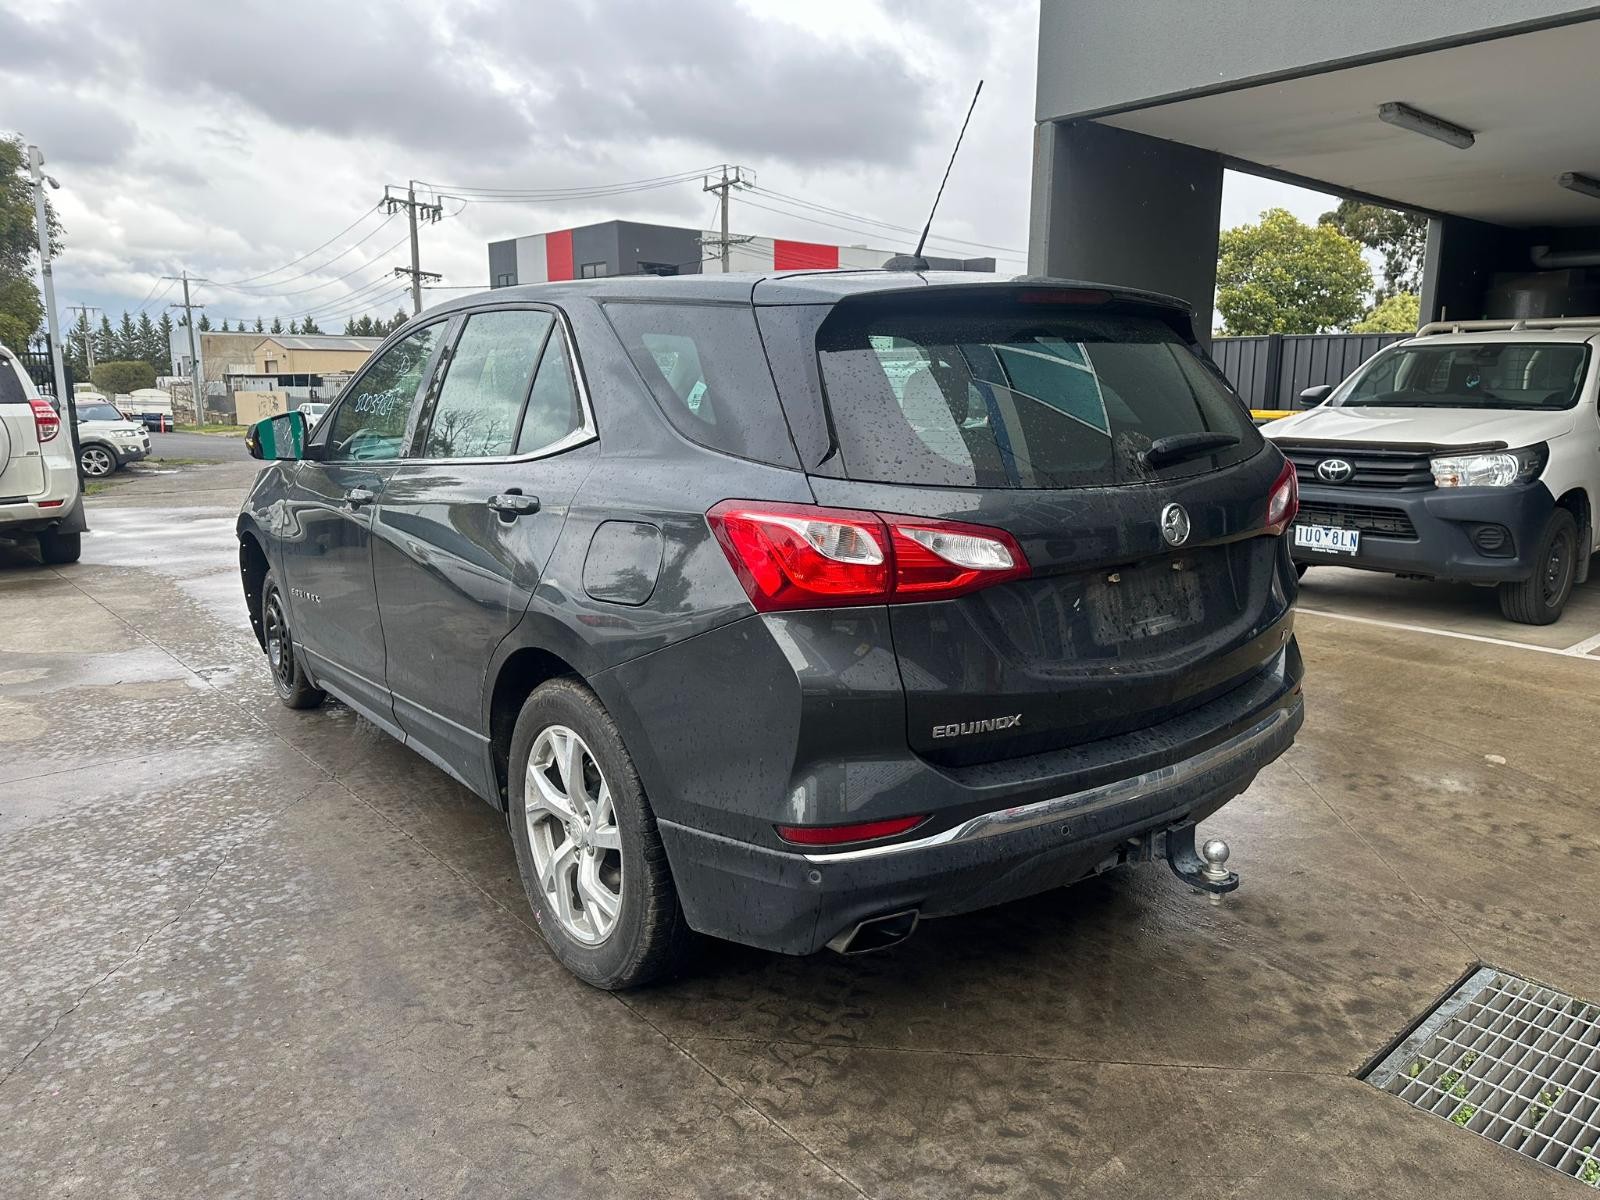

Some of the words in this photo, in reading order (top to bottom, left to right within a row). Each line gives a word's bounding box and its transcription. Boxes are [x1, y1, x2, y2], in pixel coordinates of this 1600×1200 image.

[1298, 527, 1321, 544] 1UQ
[1332, 531, 1358, 548] 8LN
[932, 713, 1022, 738] EQUINOX
